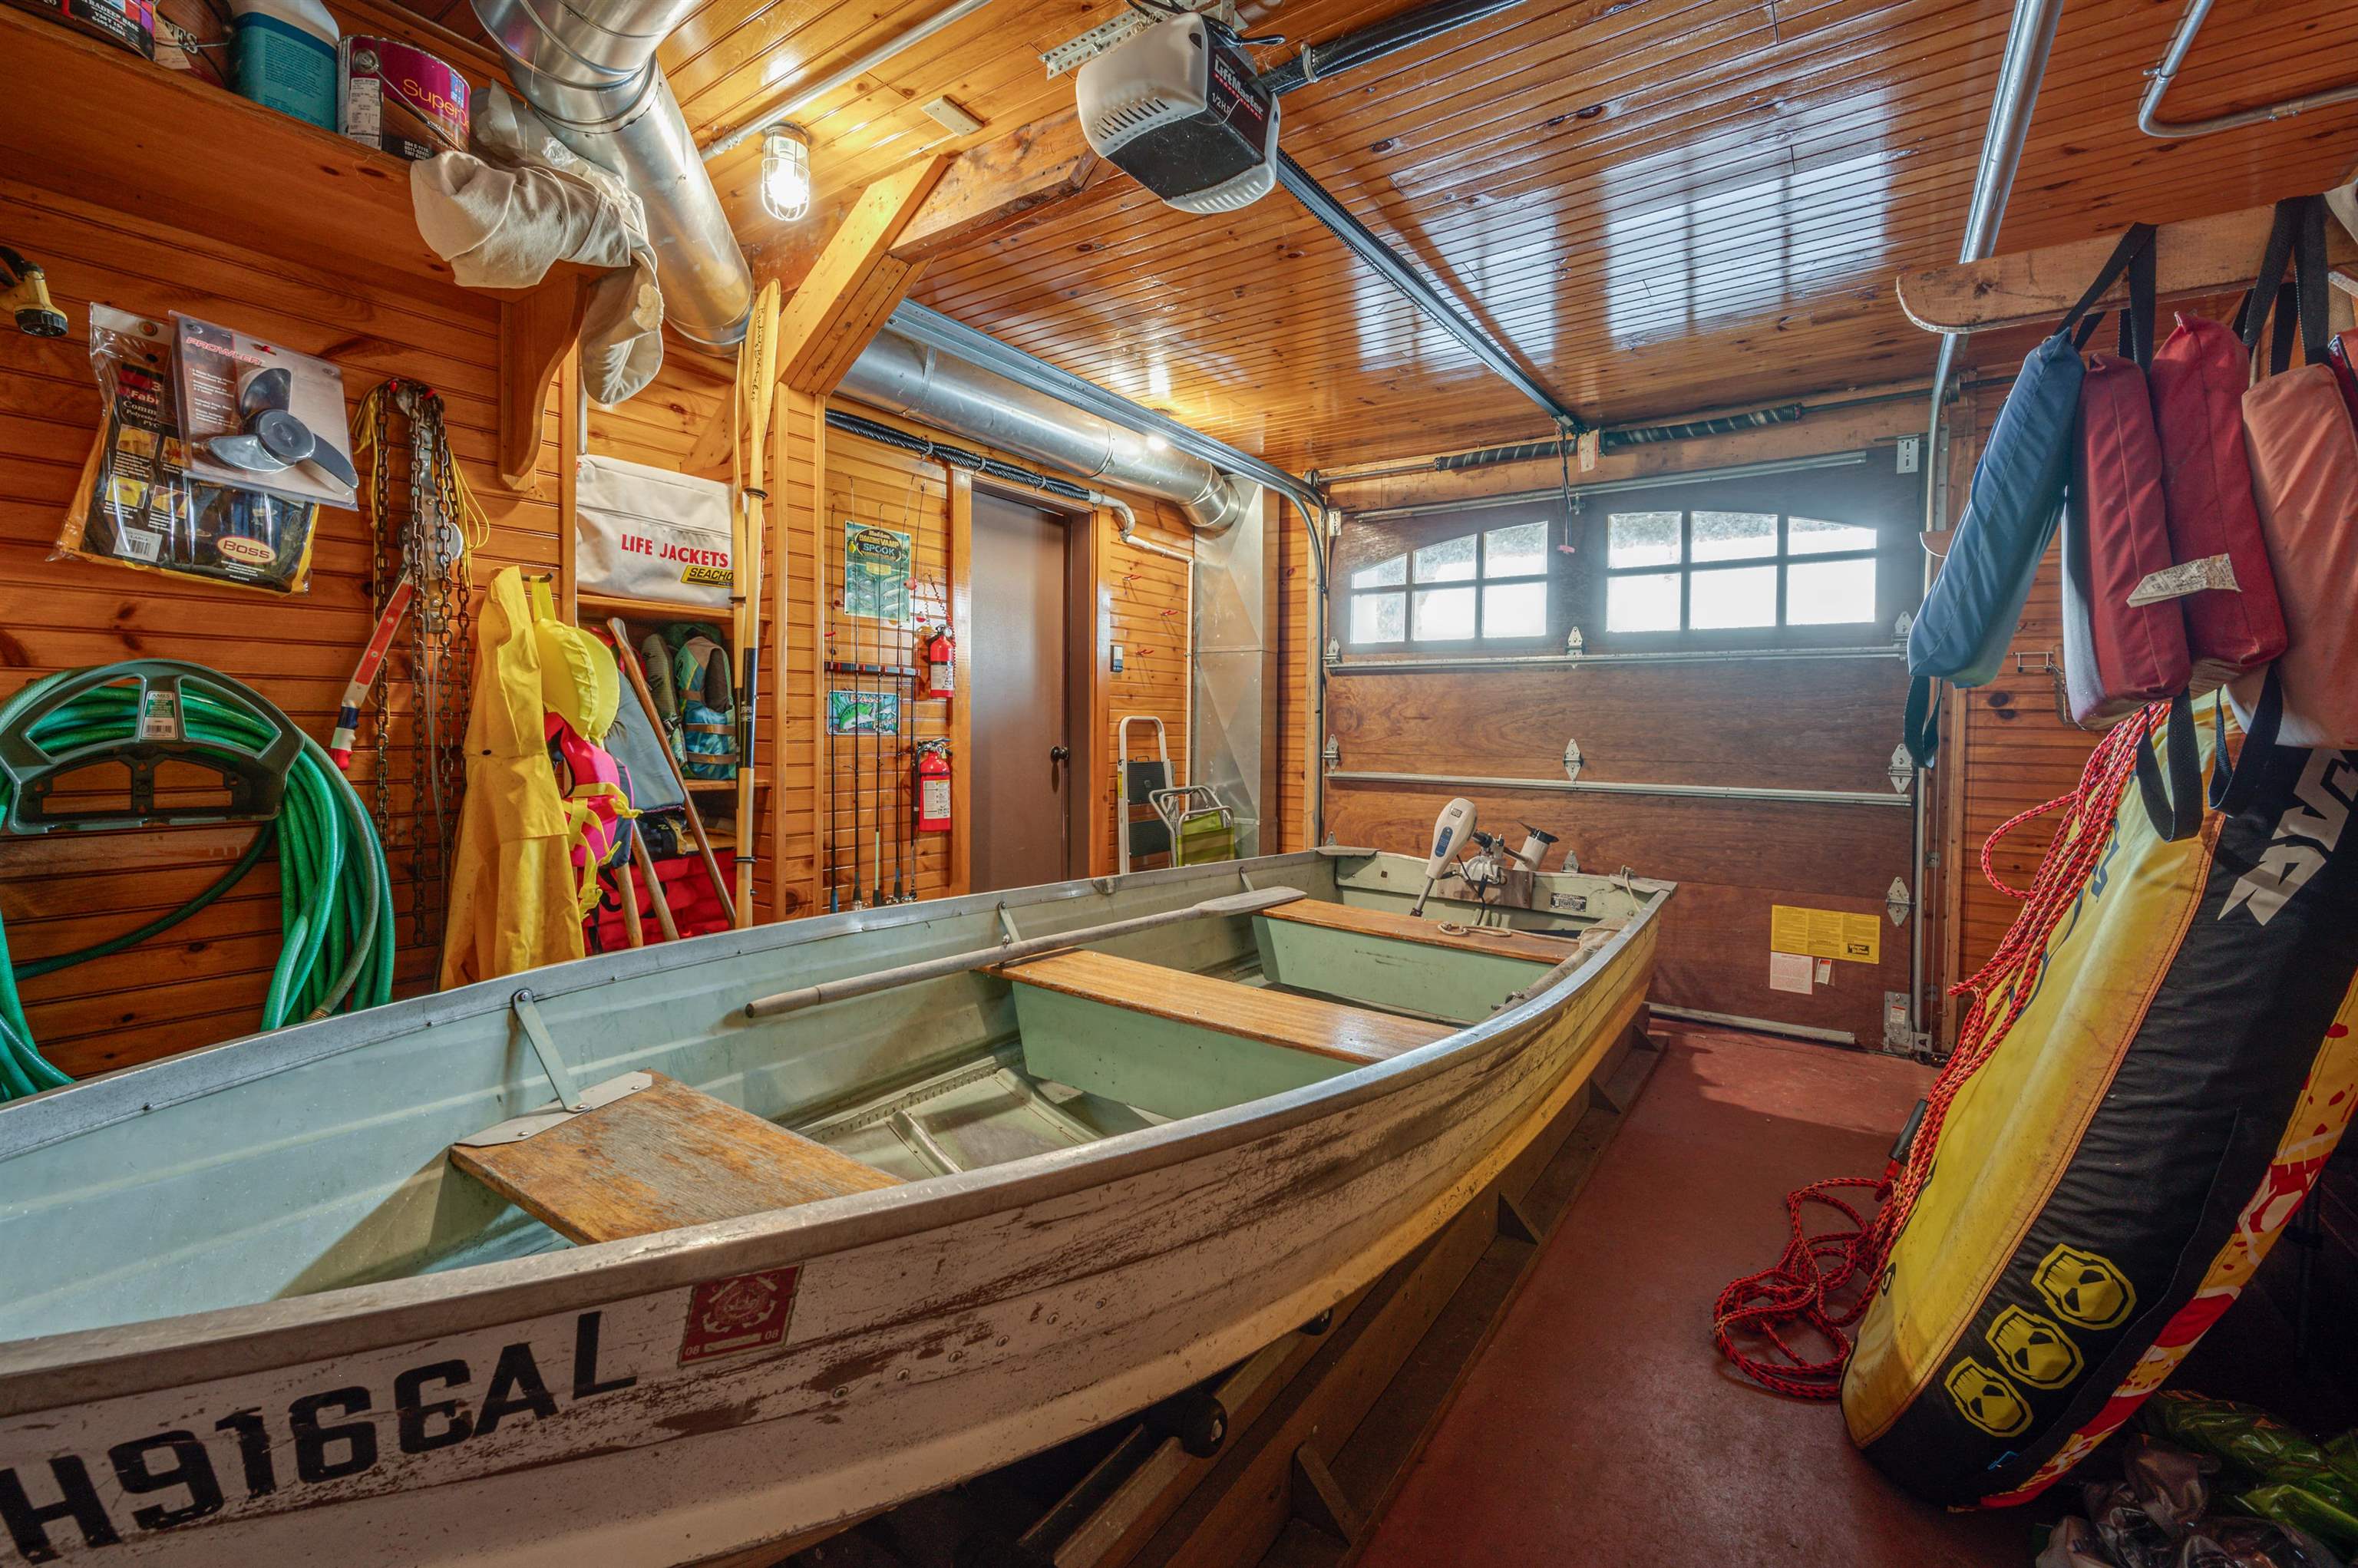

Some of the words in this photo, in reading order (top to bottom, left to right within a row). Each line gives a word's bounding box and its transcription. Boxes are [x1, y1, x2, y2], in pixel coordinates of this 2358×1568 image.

[1214, 58, 1263, 114] LiftMaster
[186, 336, 263, 367] PROWLER
[223, 540, 271, 560] BOSS
[621, 534, 652, 556] LIFE
[659, 543, 728, 568] JACKETS
[859, 534, 880, 544] FLOATING
[880, 538, 900, 548] VAMP
[863, 543, 895, 556] SPOOK
[685, 1345, 701, 1356] 08
